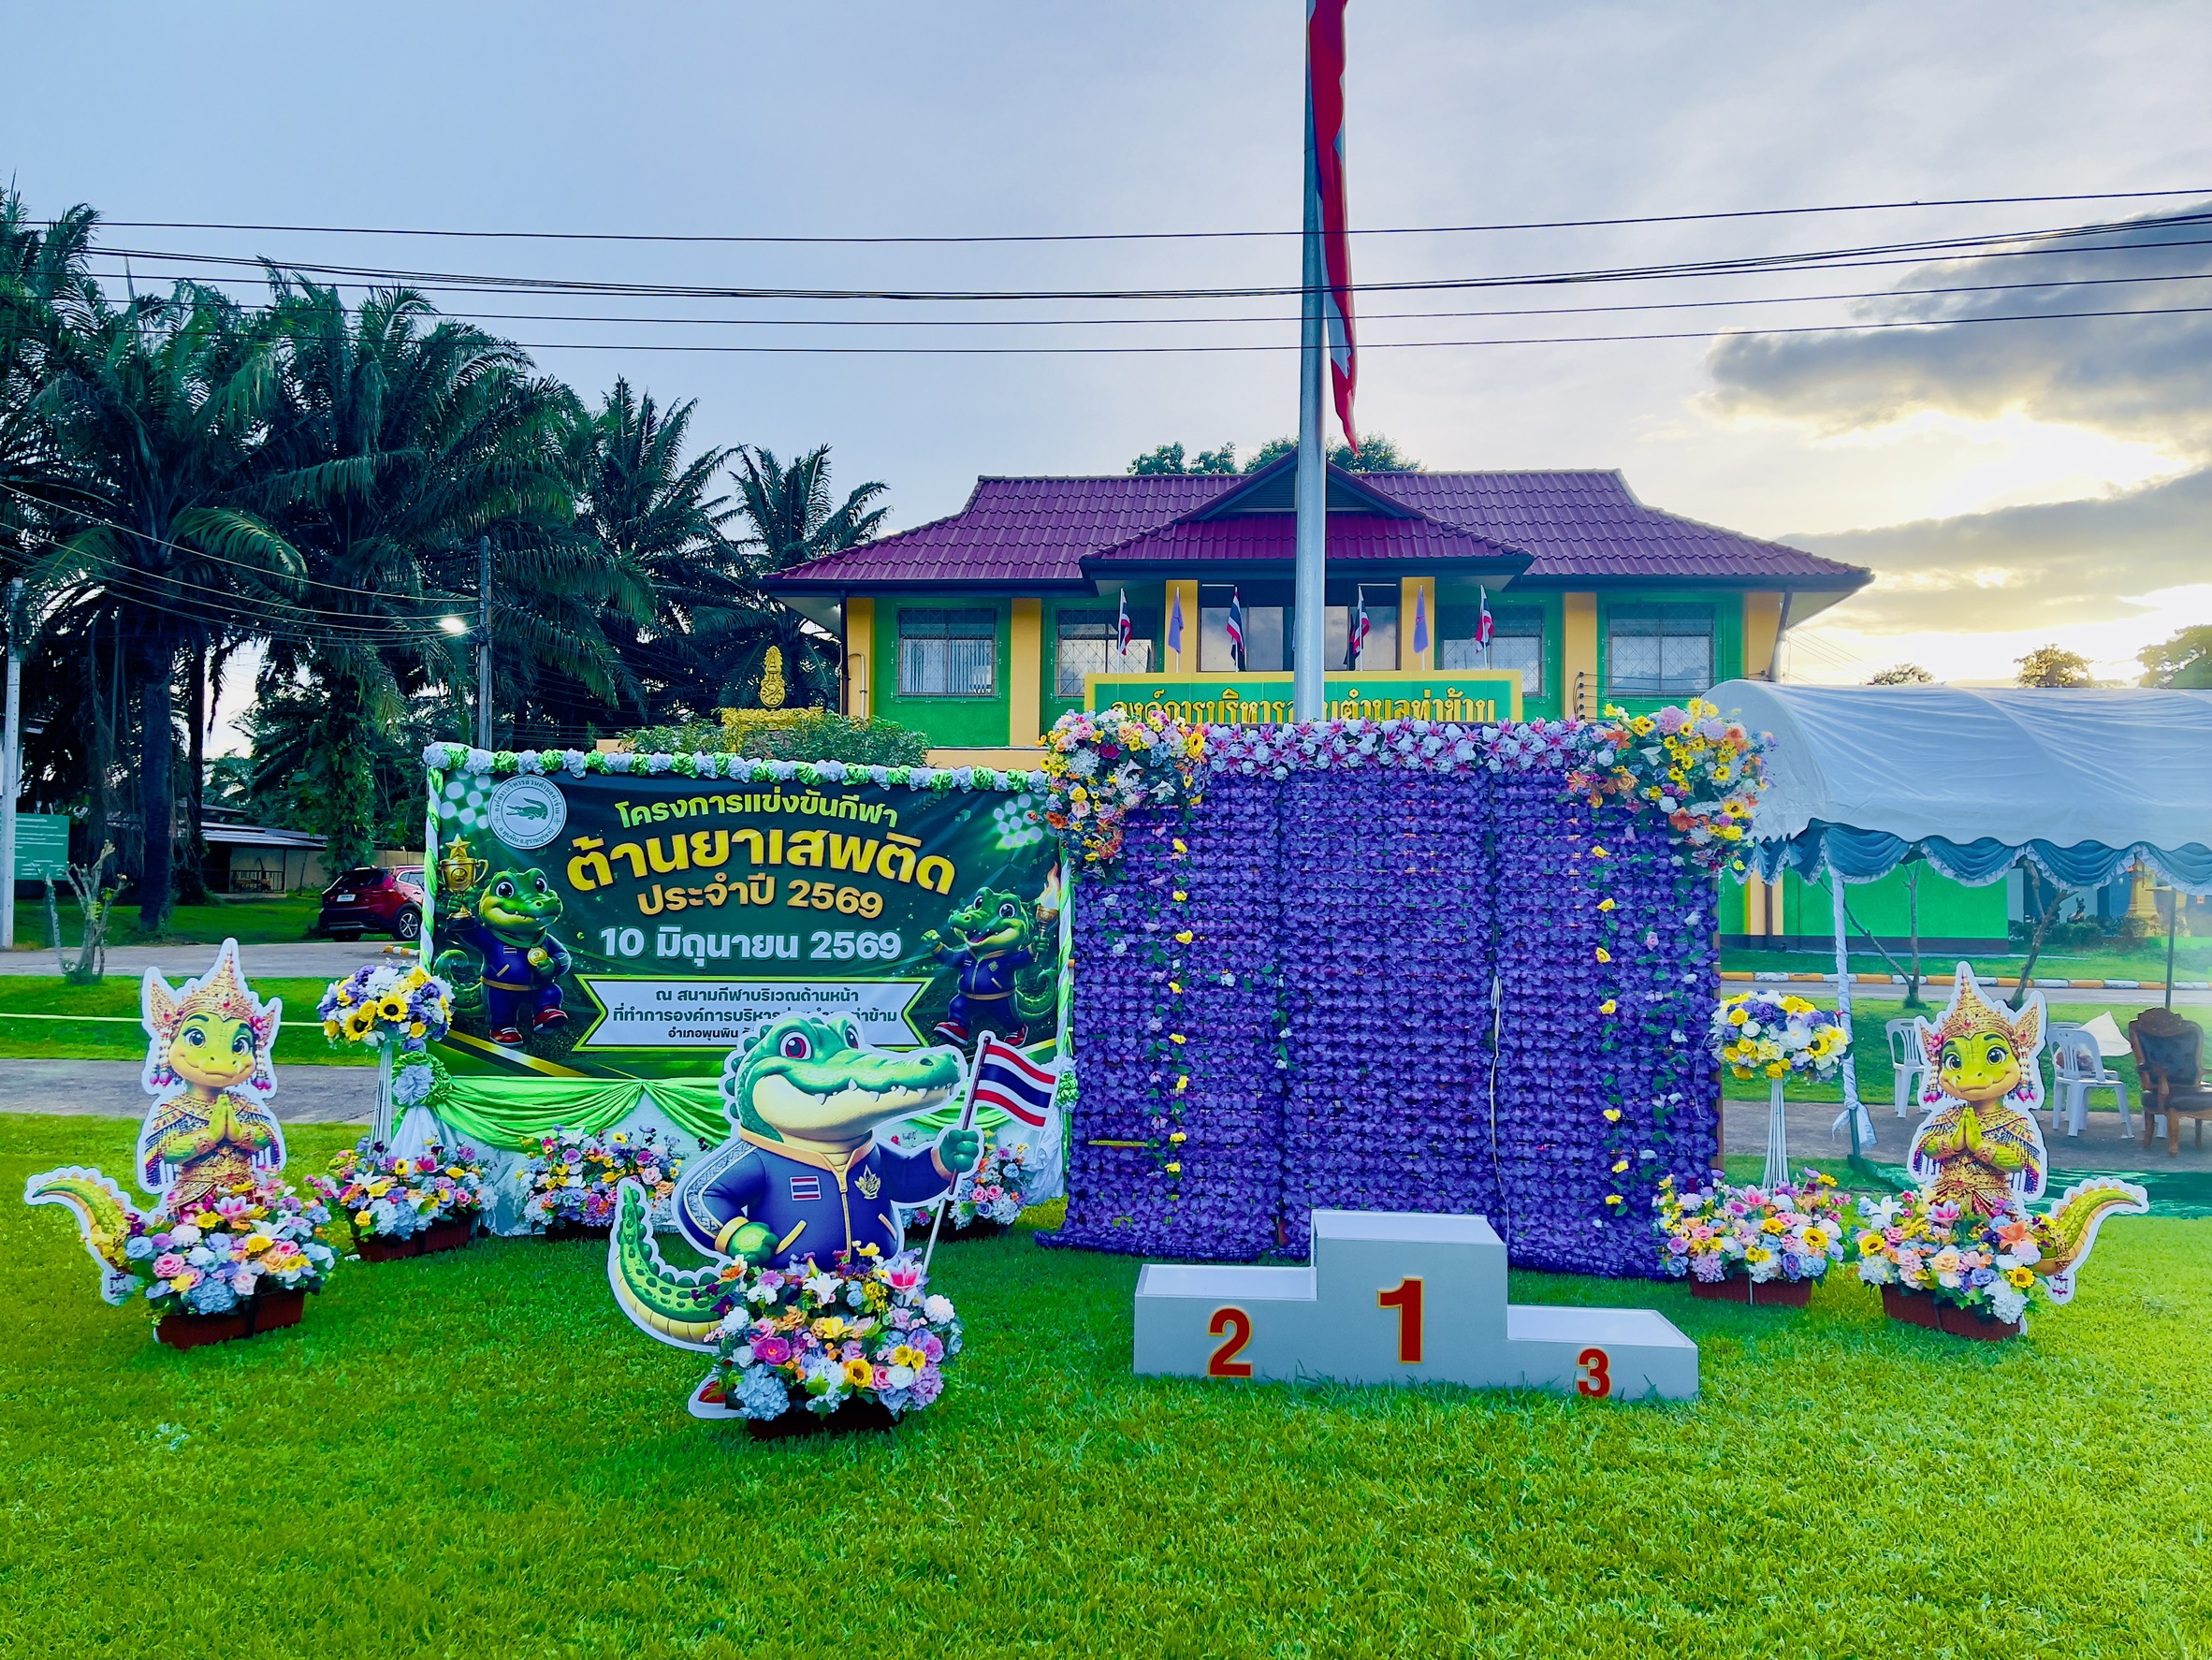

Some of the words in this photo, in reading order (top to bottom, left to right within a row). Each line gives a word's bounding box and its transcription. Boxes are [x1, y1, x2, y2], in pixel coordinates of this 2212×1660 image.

[615, 786, 898, 828] โครงการแข่งขันกีฬา
[566, 828, 955, 896] ต้านยาเสพติด
[637, 872, 776, 916] ประจำปี
[787, 880, 884, 919] 2569
[601, 927, 645, 957] 10
[657, 925, 798, 968] มิถุนายน
[810, 931, 902, 960] 2569
[655, 989, 672, 1001] ณ
[677, 986, 859, 1002] สนามกีฬาบริเวณด้านหน้า
[668, 1027, 739, 1041] อำเภอพุนพิน
[1207, 1306, 1253, 1378] 2
[1376, 1277, 1424, 1364] 1
[1575, 1347, 1611, 1398] 3
